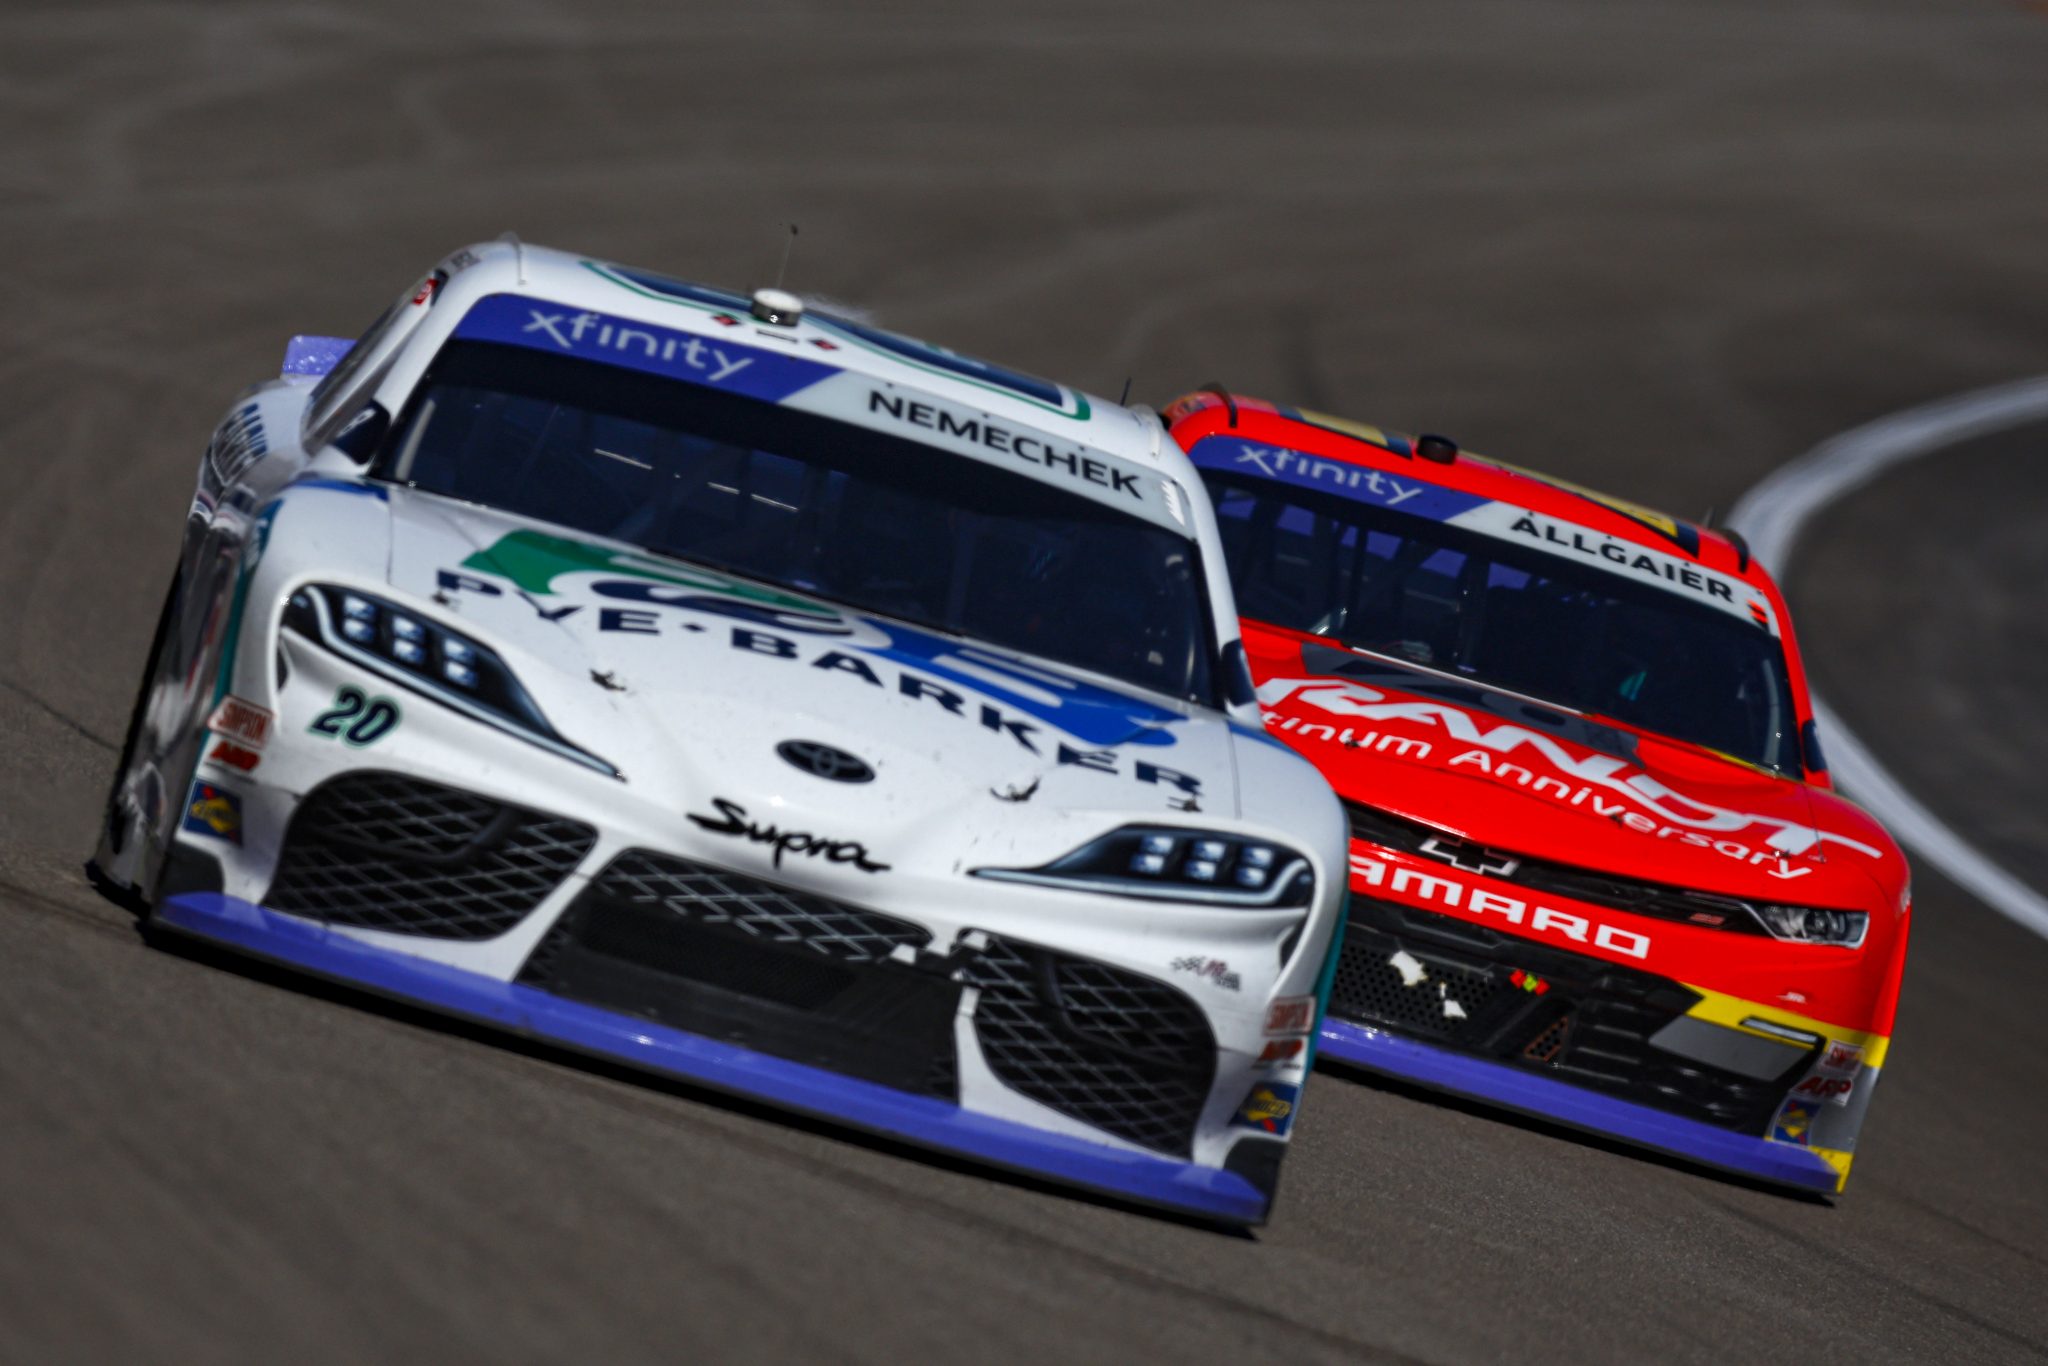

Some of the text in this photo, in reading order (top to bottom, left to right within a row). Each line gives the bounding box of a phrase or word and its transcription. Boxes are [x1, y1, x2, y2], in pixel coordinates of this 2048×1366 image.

[523, 310, 755, 382] xfinity
[869, 390, 1143, 500] NEMECHEK
[1236, 445, 1423, 505] xfinity
[1510, 516, 1734, 603] ALLGAIER
[305, 683, 403, 749] 20
[685, 796, 892, 873] Supra
[1449, 750, 1813, 879] Anniversary
